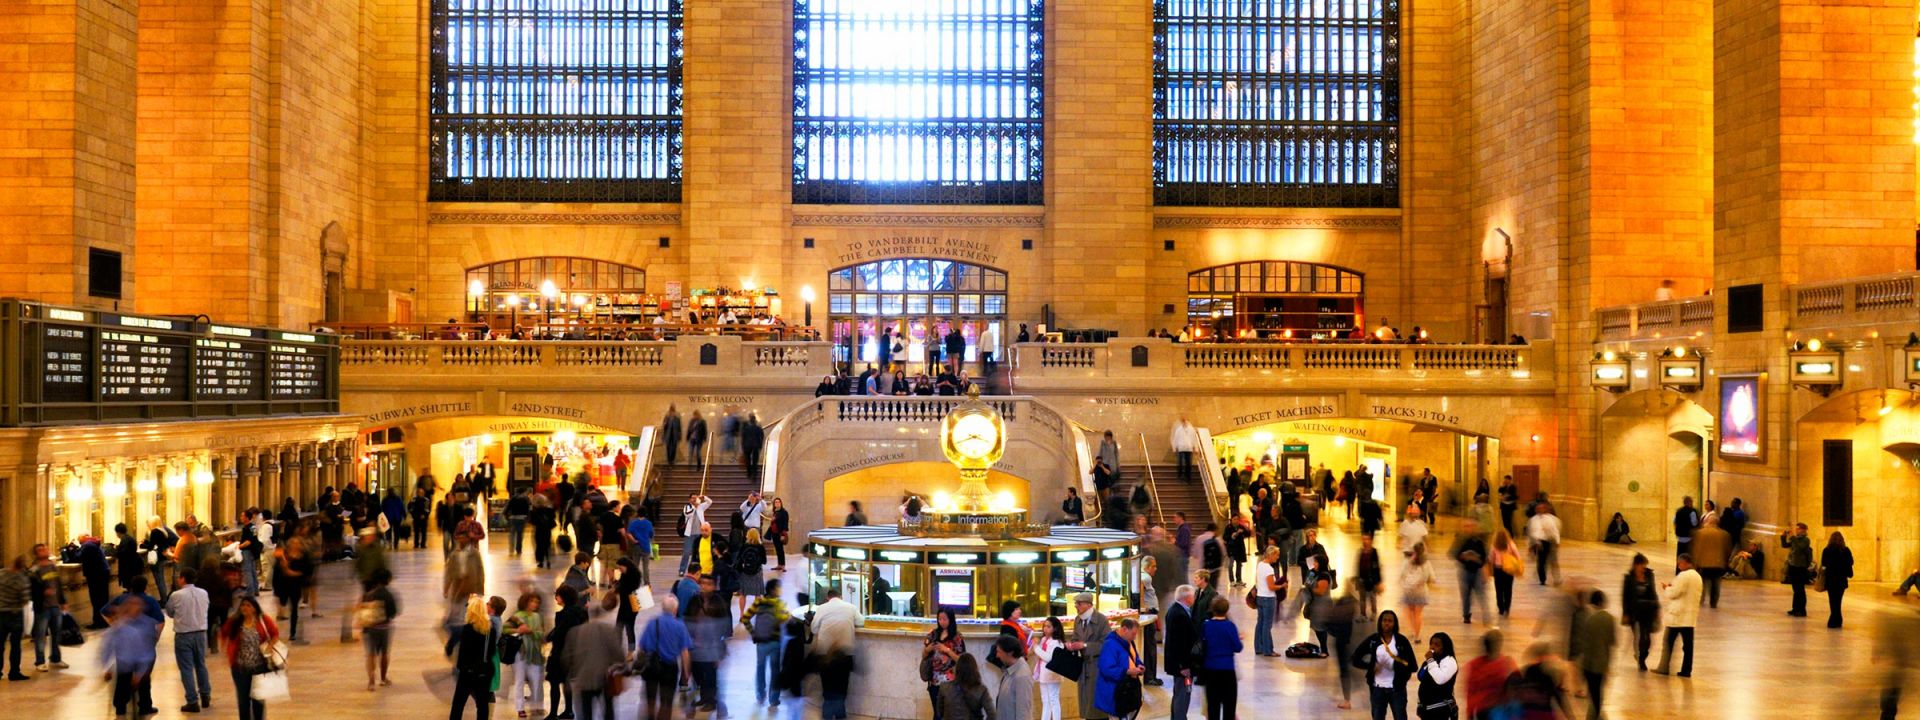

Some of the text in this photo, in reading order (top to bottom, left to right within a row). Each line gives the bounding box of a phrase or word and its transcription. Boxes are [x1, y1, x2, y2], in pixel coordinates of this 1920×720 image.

[848, 236, 991, 252] TO VANDERBILT AVENUE
[838, 245, 999, 264] THE CAMPBELL APARTMENT
[688, 395, 754, 403] WEST BALCONY
[369, 402, 472, 423] SUBWAY SHUTTLE
[511, 403, 586, 419] 42ND STREET
[1233, 404, 1334, 426] TICKET MACHINES
[1372, 405, 1459, 425] TRACKS 31 TO 42
[488, 421, 529, 432] SUBWAY
[531, 420, 576, 432] SHUTTLE
[1293, 422, 1367, 437] WAITING ROOM
[828, 452, 905, 475] DINING CONCOURSE
[958, 514, 1009, 525] Information
